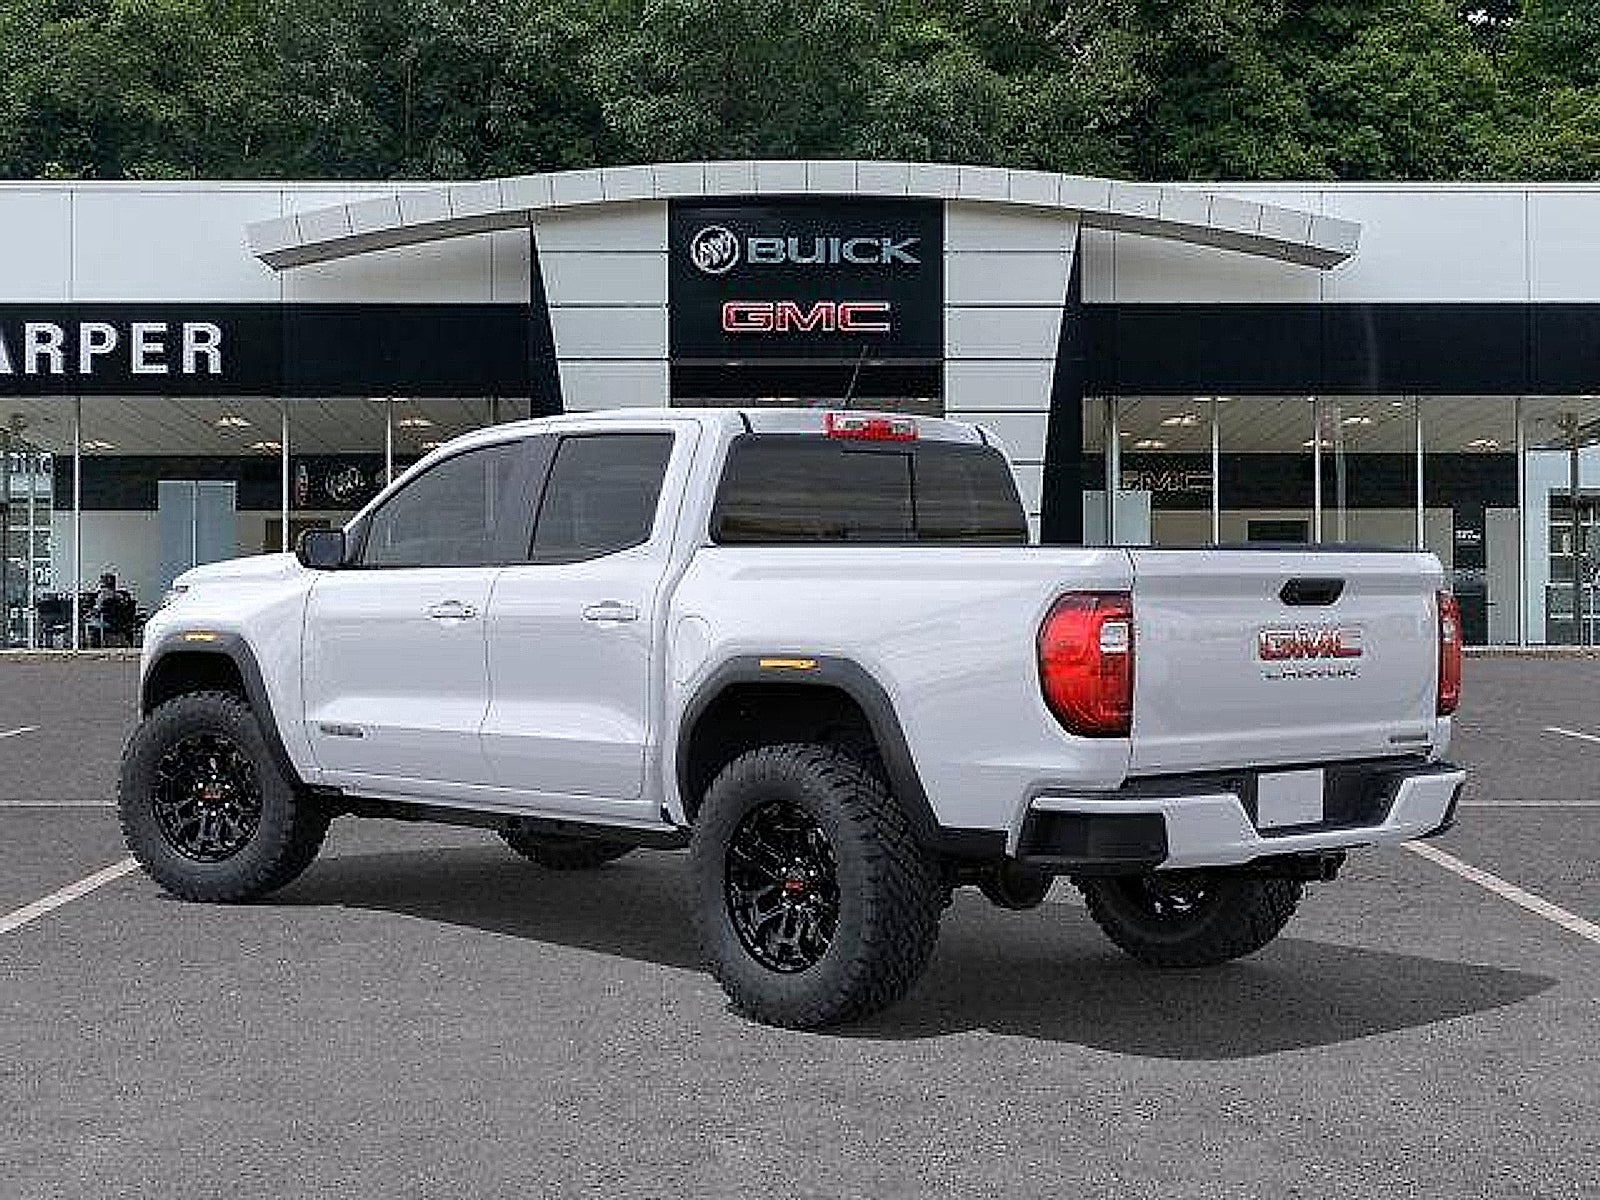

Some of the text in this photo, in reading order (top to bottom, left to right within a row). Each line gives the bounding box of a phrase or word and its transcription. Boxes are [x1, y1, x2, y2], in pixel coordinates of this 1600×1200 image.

[747, 237, 922, 264] BUICK
[722, 302, 891, 332] GMC
[1258, 626, 1363, 661] GMC
